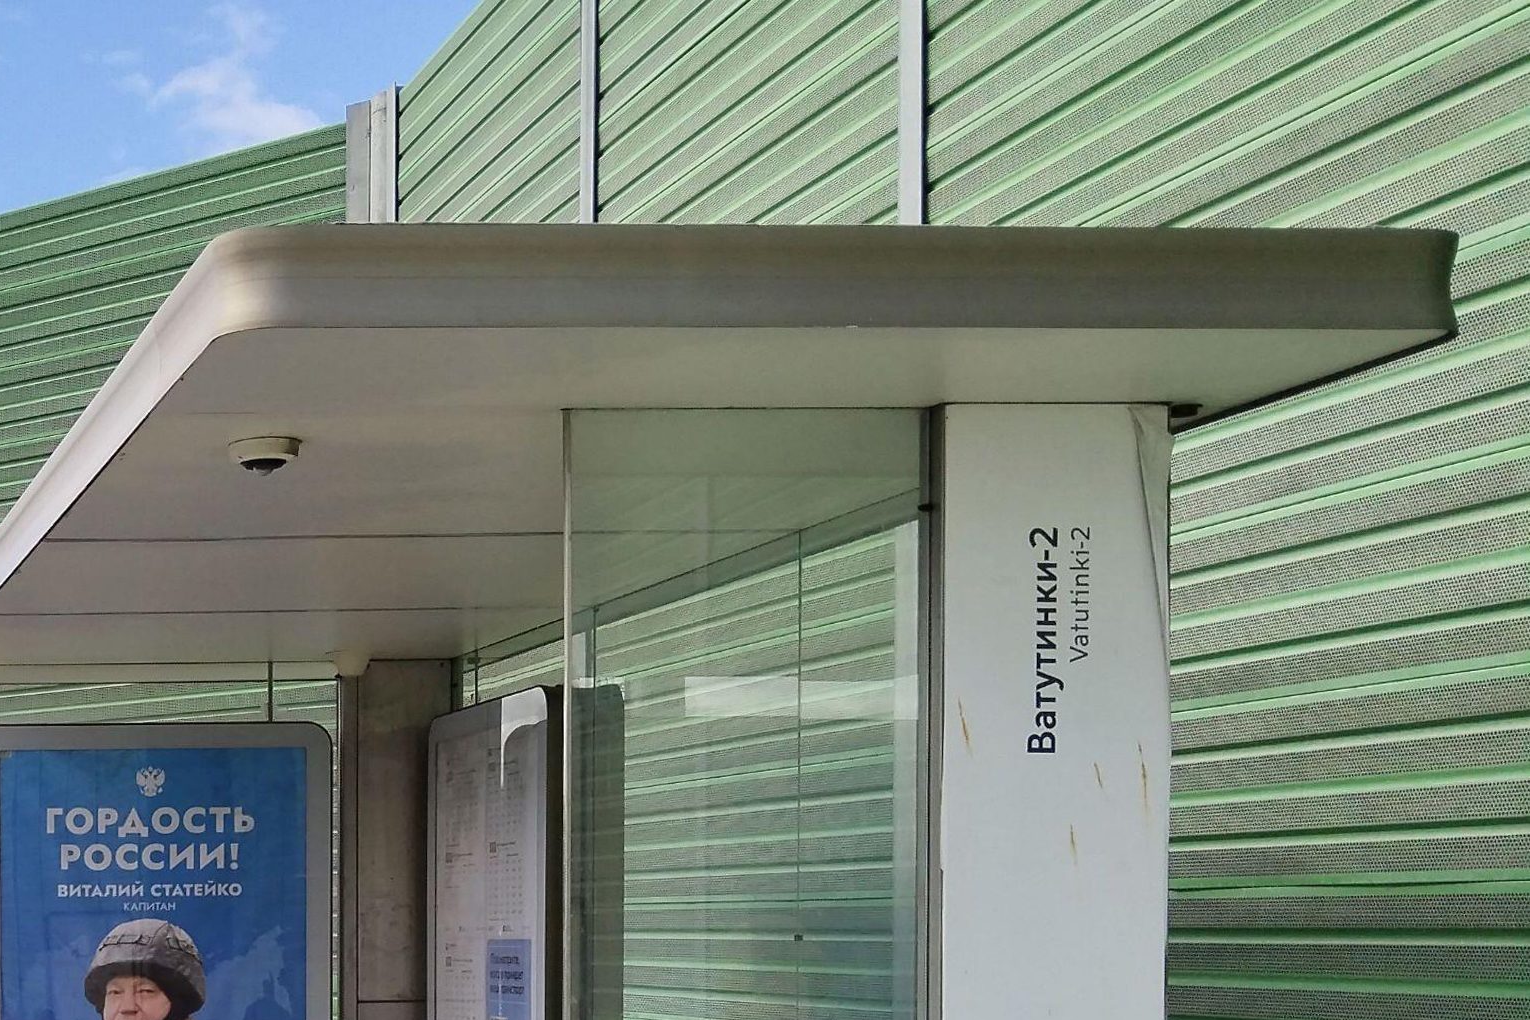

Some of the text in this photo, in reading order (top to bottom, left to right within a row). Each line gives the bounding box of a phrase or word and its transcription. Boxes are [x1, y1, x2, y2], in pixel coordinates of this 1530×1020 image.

[1069, 526, 1092, 663] Vatutinki-2
[1026, 526, 1065, 754] Ватутинки-2
[45, 806, 256, 838] ГОРДОСТЬ
[59, 842, 240, 872] РОССИИ!
[56, 881, 243, 898] ВИТАЛИЙ СТАТЕЙКО
[122, 901, 177, 912] КАПИТАН
